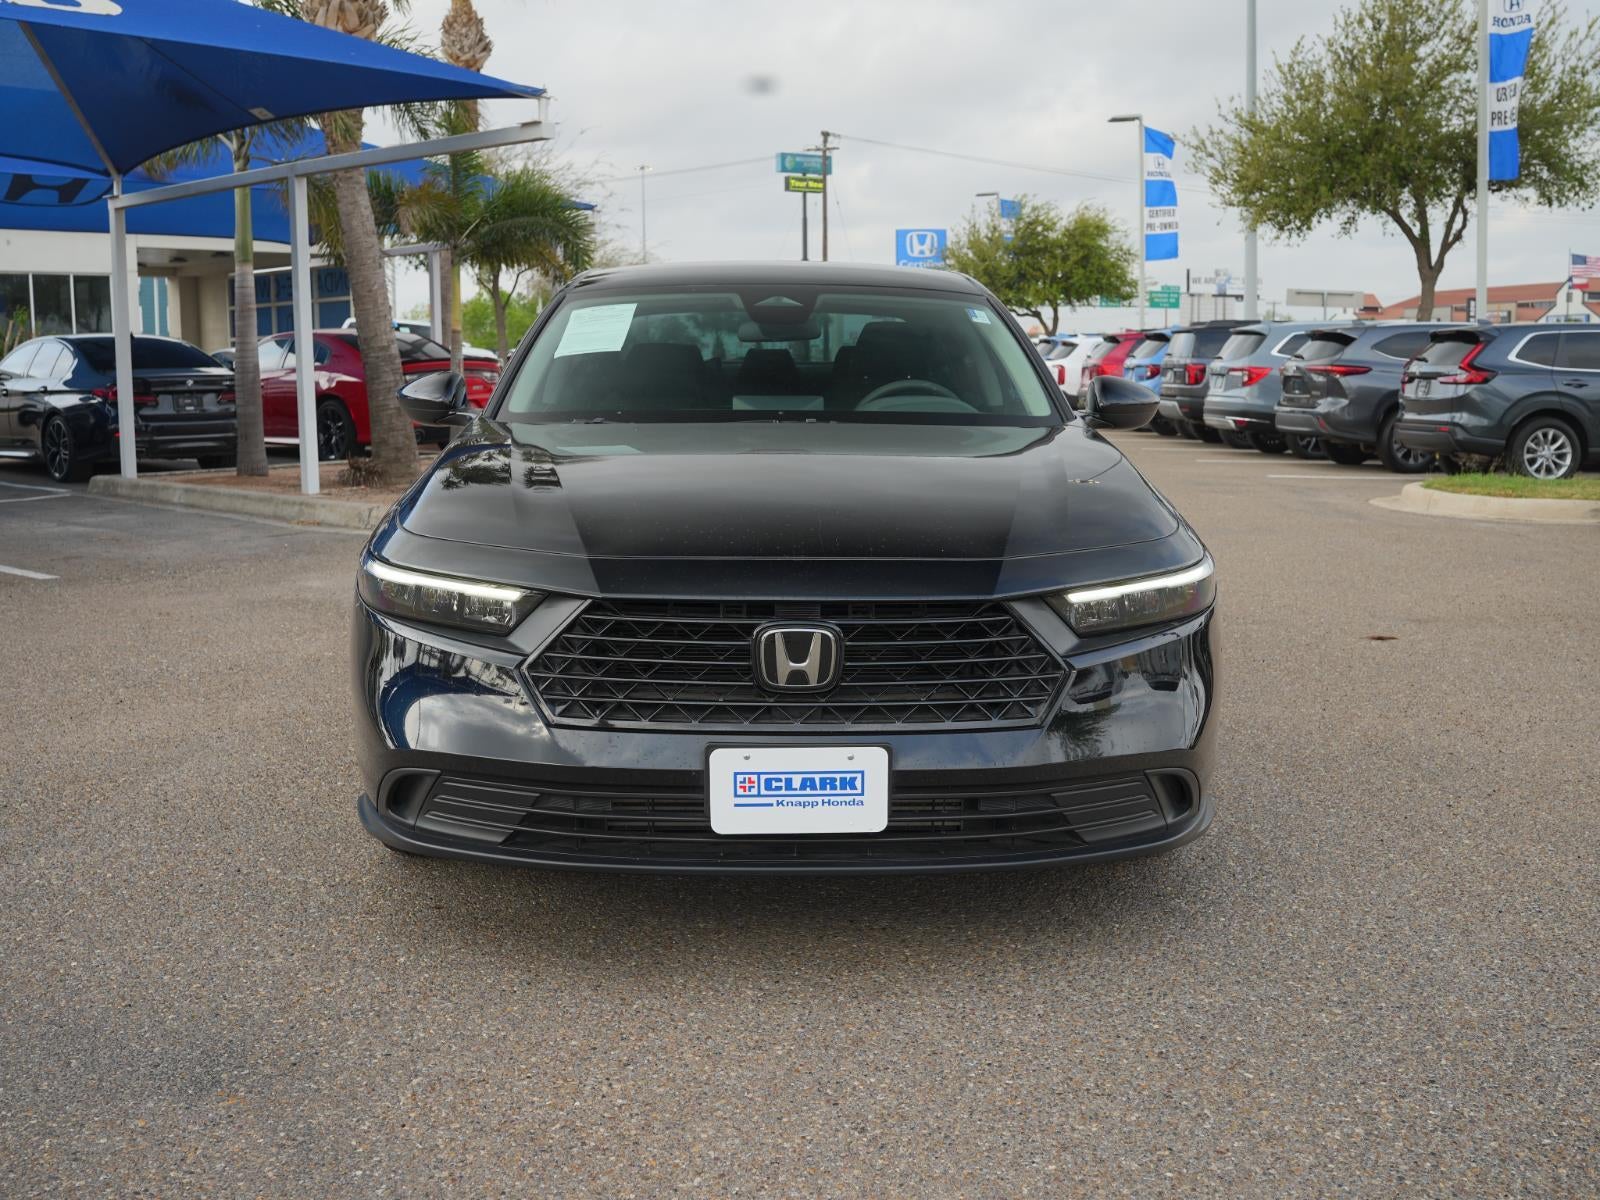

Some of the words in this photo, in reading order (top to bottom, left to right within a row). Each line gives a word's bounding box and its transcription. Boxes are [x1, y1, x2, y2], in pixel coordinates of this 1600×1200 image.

[1492, 14, 1531, 27] HONDA
[1146, 221, 1179, 231] PRE-OWNED
[764, 776, 858, 792] CLARK
[776, 799, 819, 809] Knapp
[821, 798, 864, 807] Honda
